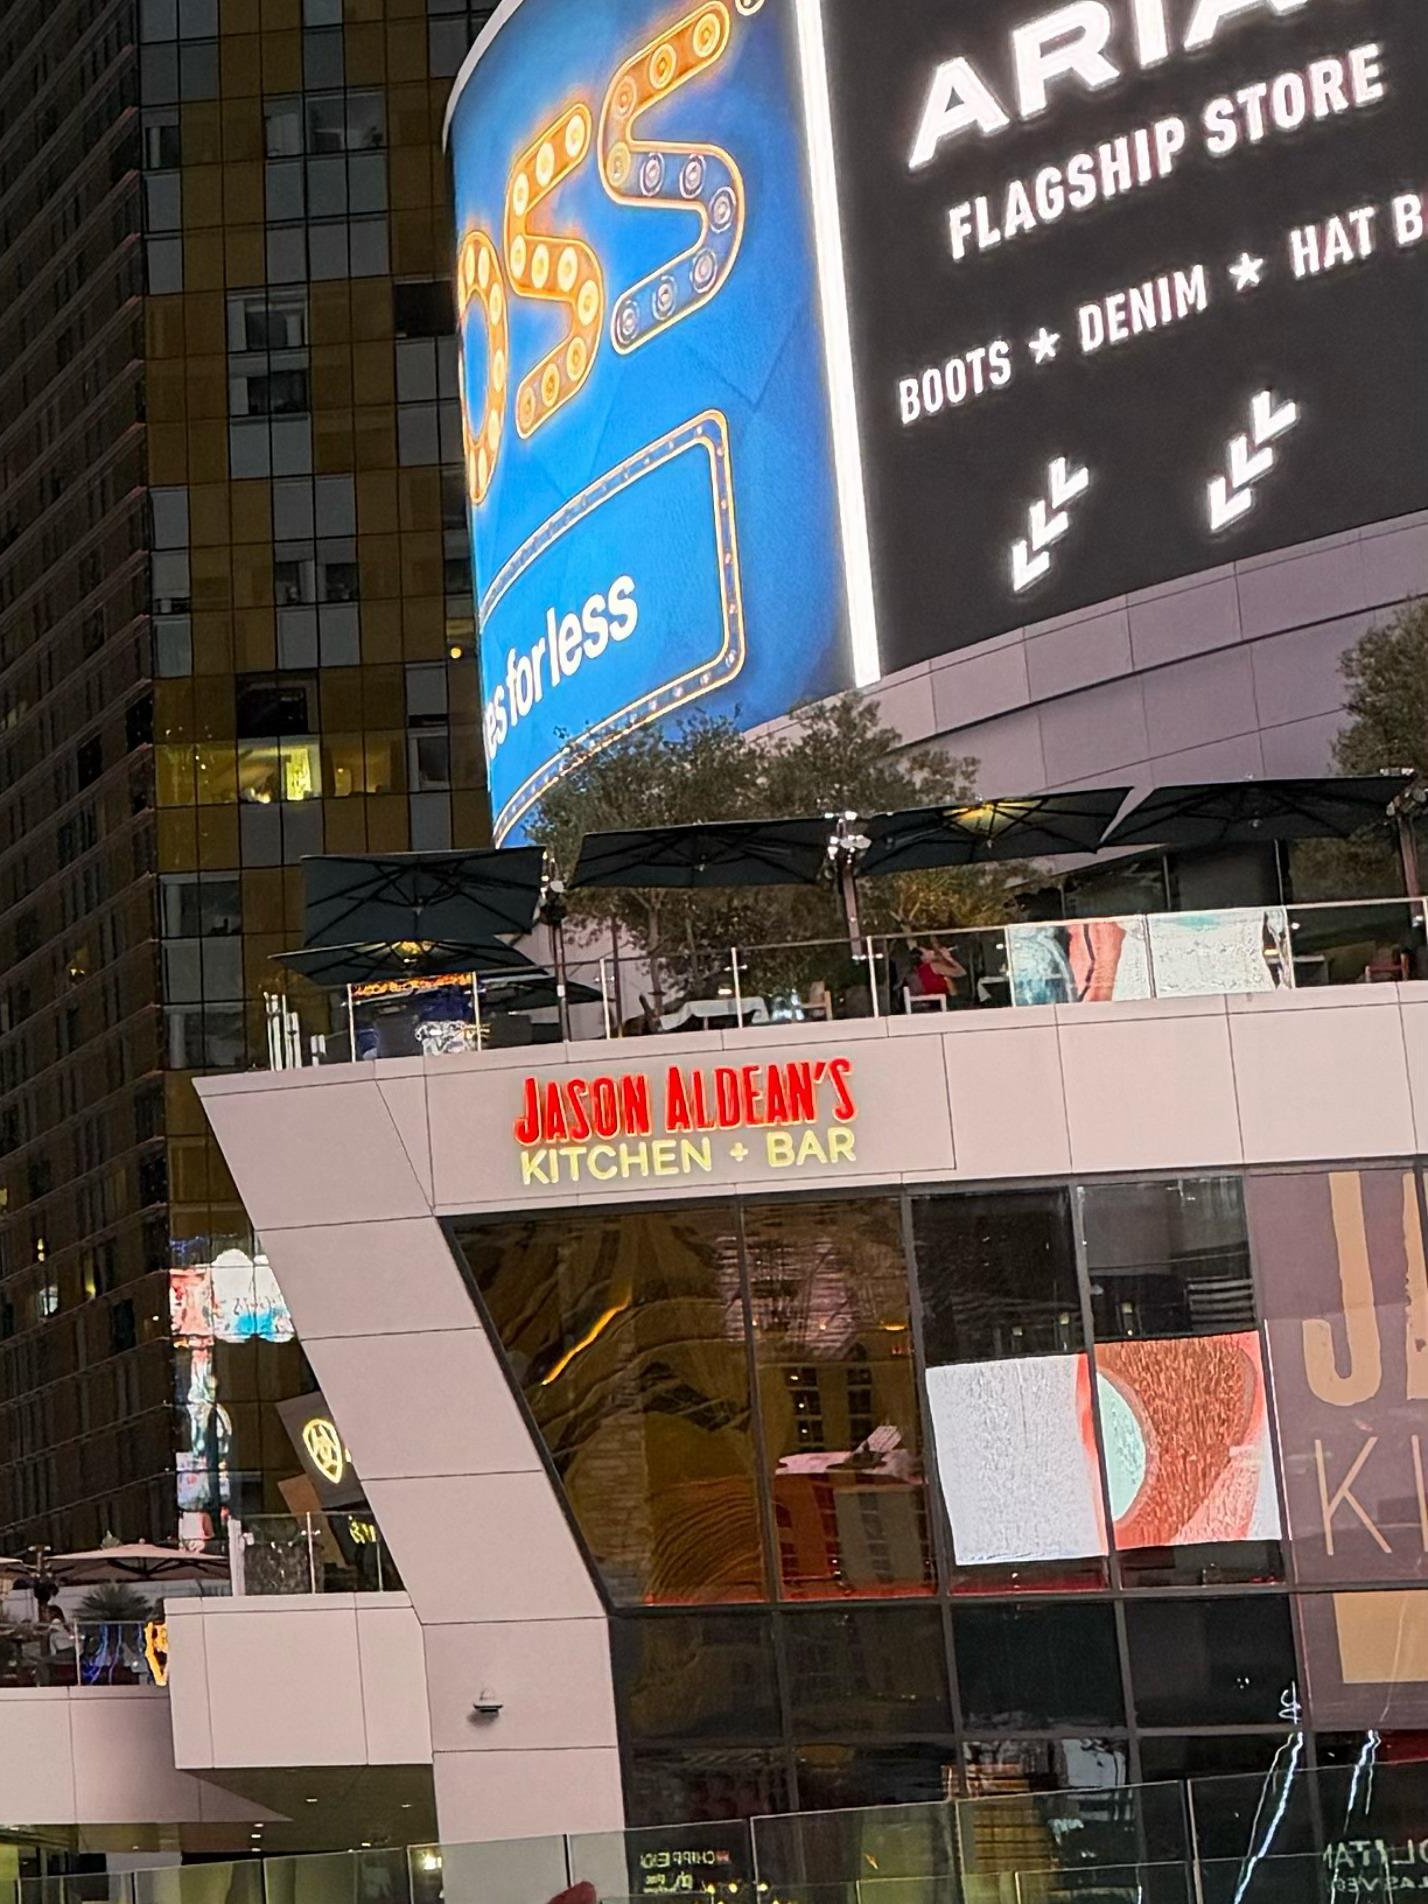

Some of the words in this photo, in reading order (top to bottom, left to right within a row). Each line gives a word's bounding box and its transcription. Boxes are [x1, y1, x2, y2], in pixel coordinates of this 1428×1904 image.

[945, 105, 1191, 264] FLAGSHIP
[1205, 42, 1386, 158] STORE
[898, 339, 1012, 428] BOOTS
[1077, 263, 1209, 352] DENIM
[1289, 206, 1376, 279] HAT
[507, 636, 546, 728] for
[546, 574, 639, 688] less
[513, 1067, 650, 1147] JASON
[663, 1055, 858, 1136] ALDEAN'S
[519, 1134, 713, 1187] KITCHEN
[766, 1125, 857, 1169] BAR
